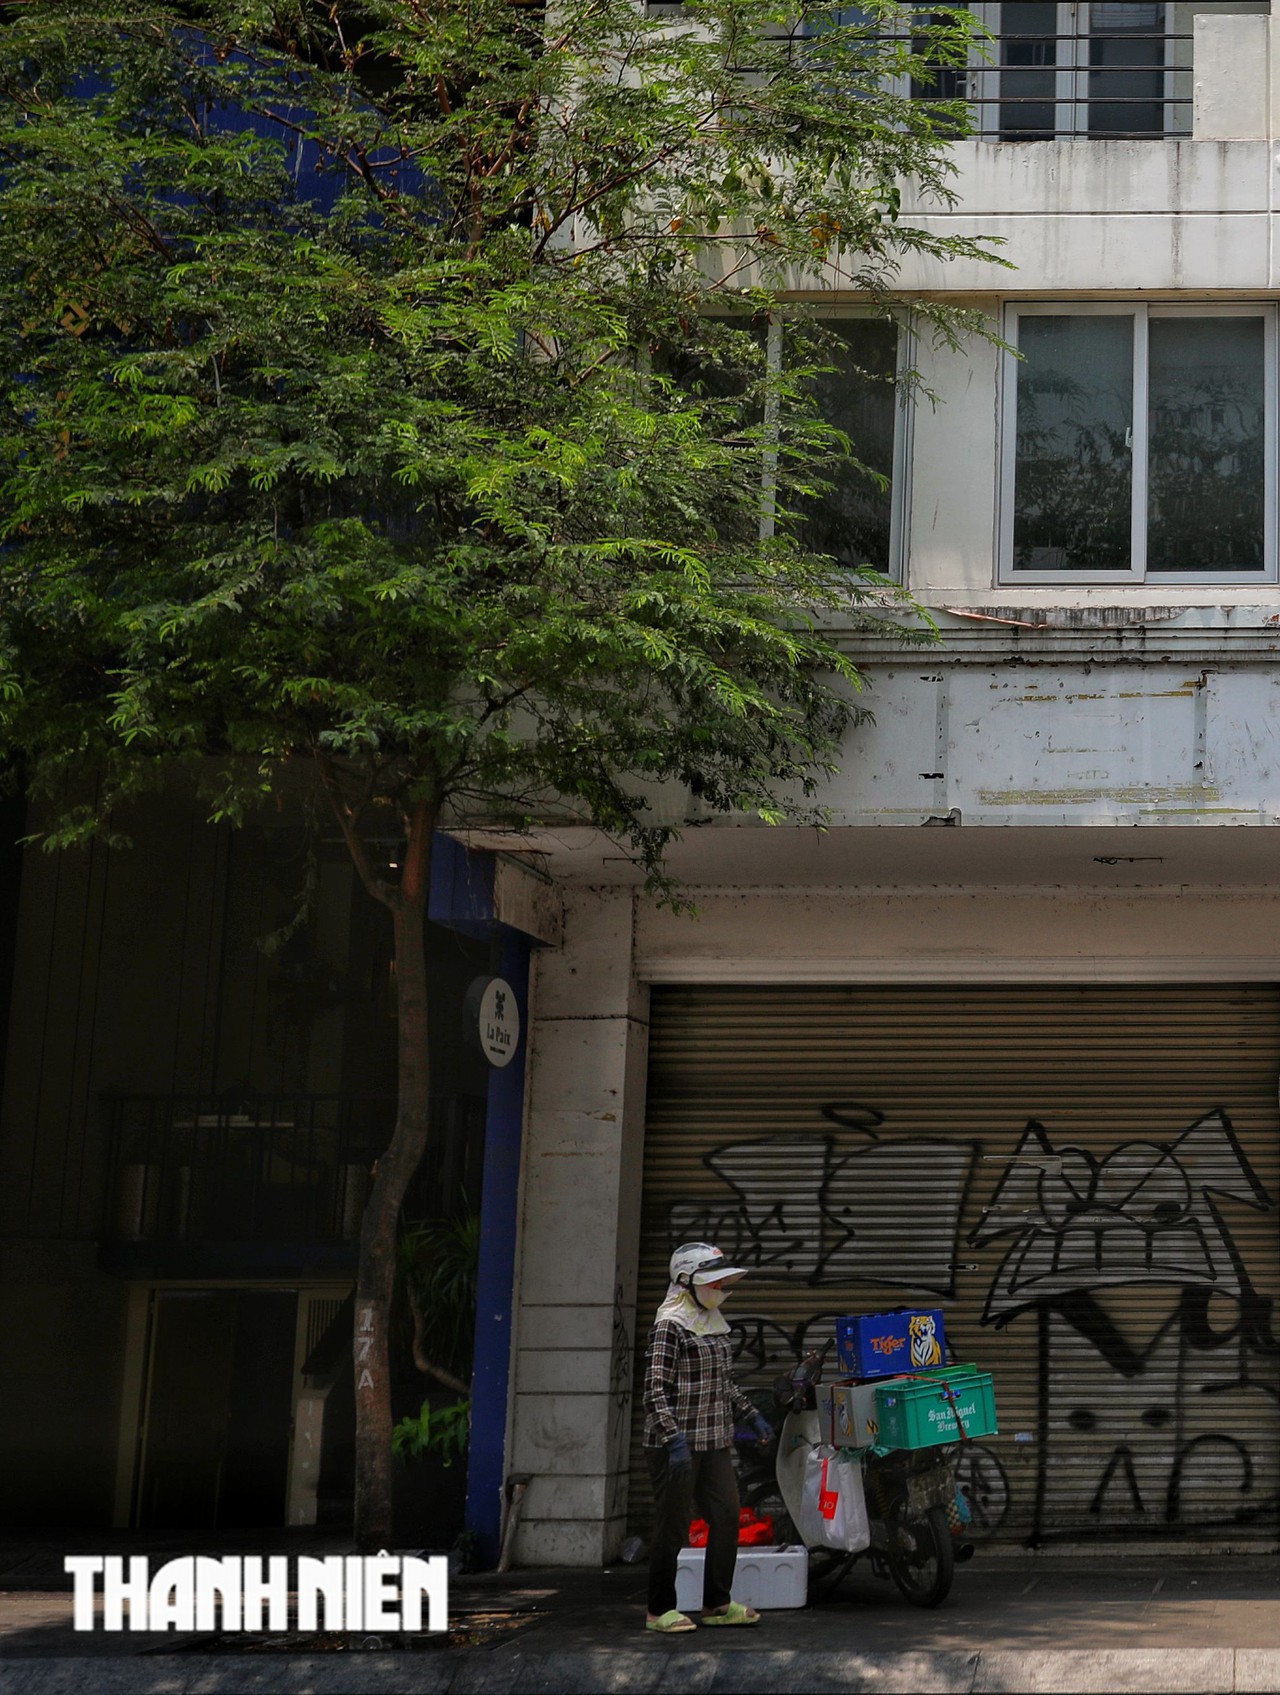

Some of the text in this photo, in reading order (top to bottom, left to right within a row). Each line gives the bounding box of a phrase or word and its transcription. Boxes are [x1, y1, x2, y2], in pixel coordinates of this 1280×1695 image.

[496, 1026, 511, 1046] Paix
[870, 1335, 906, 1355] Tiger
[928, 1408, 946, 1422] San
